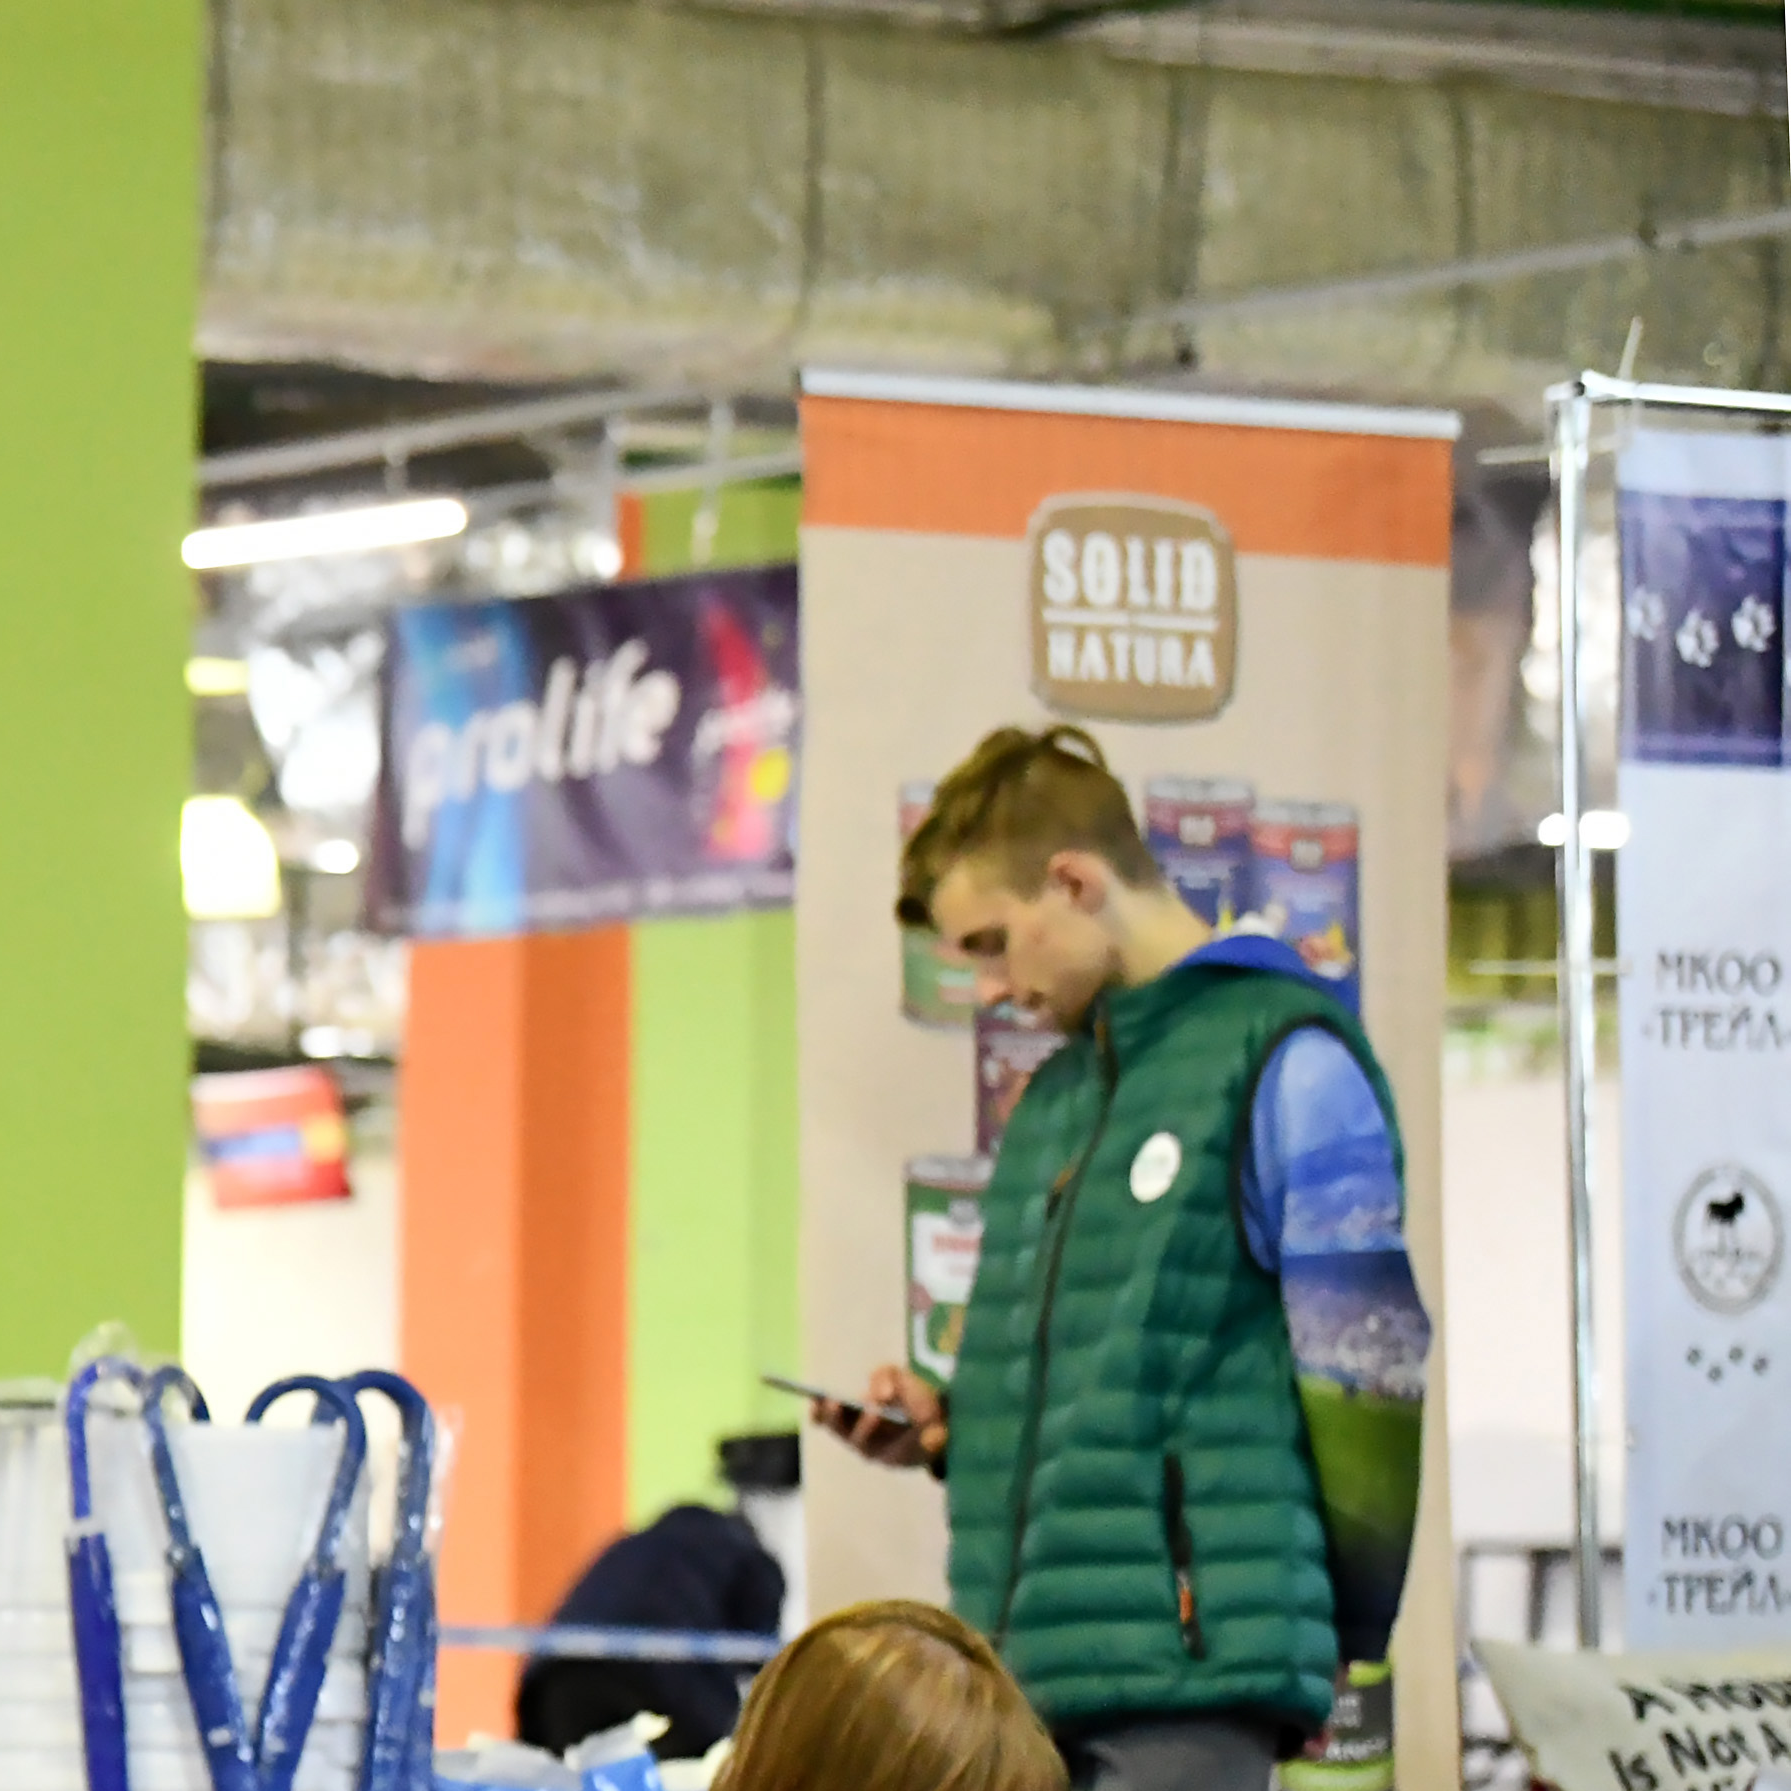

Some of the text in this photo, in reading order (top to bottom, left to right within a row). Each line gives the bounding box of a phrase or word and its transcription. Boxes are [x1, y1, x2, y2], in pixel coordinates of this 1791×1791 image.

[1042, 527, 1217, 611] SOLID
[1047, 629, 1216, 688] NATURA
[401, 636, 681, 852] prolife
